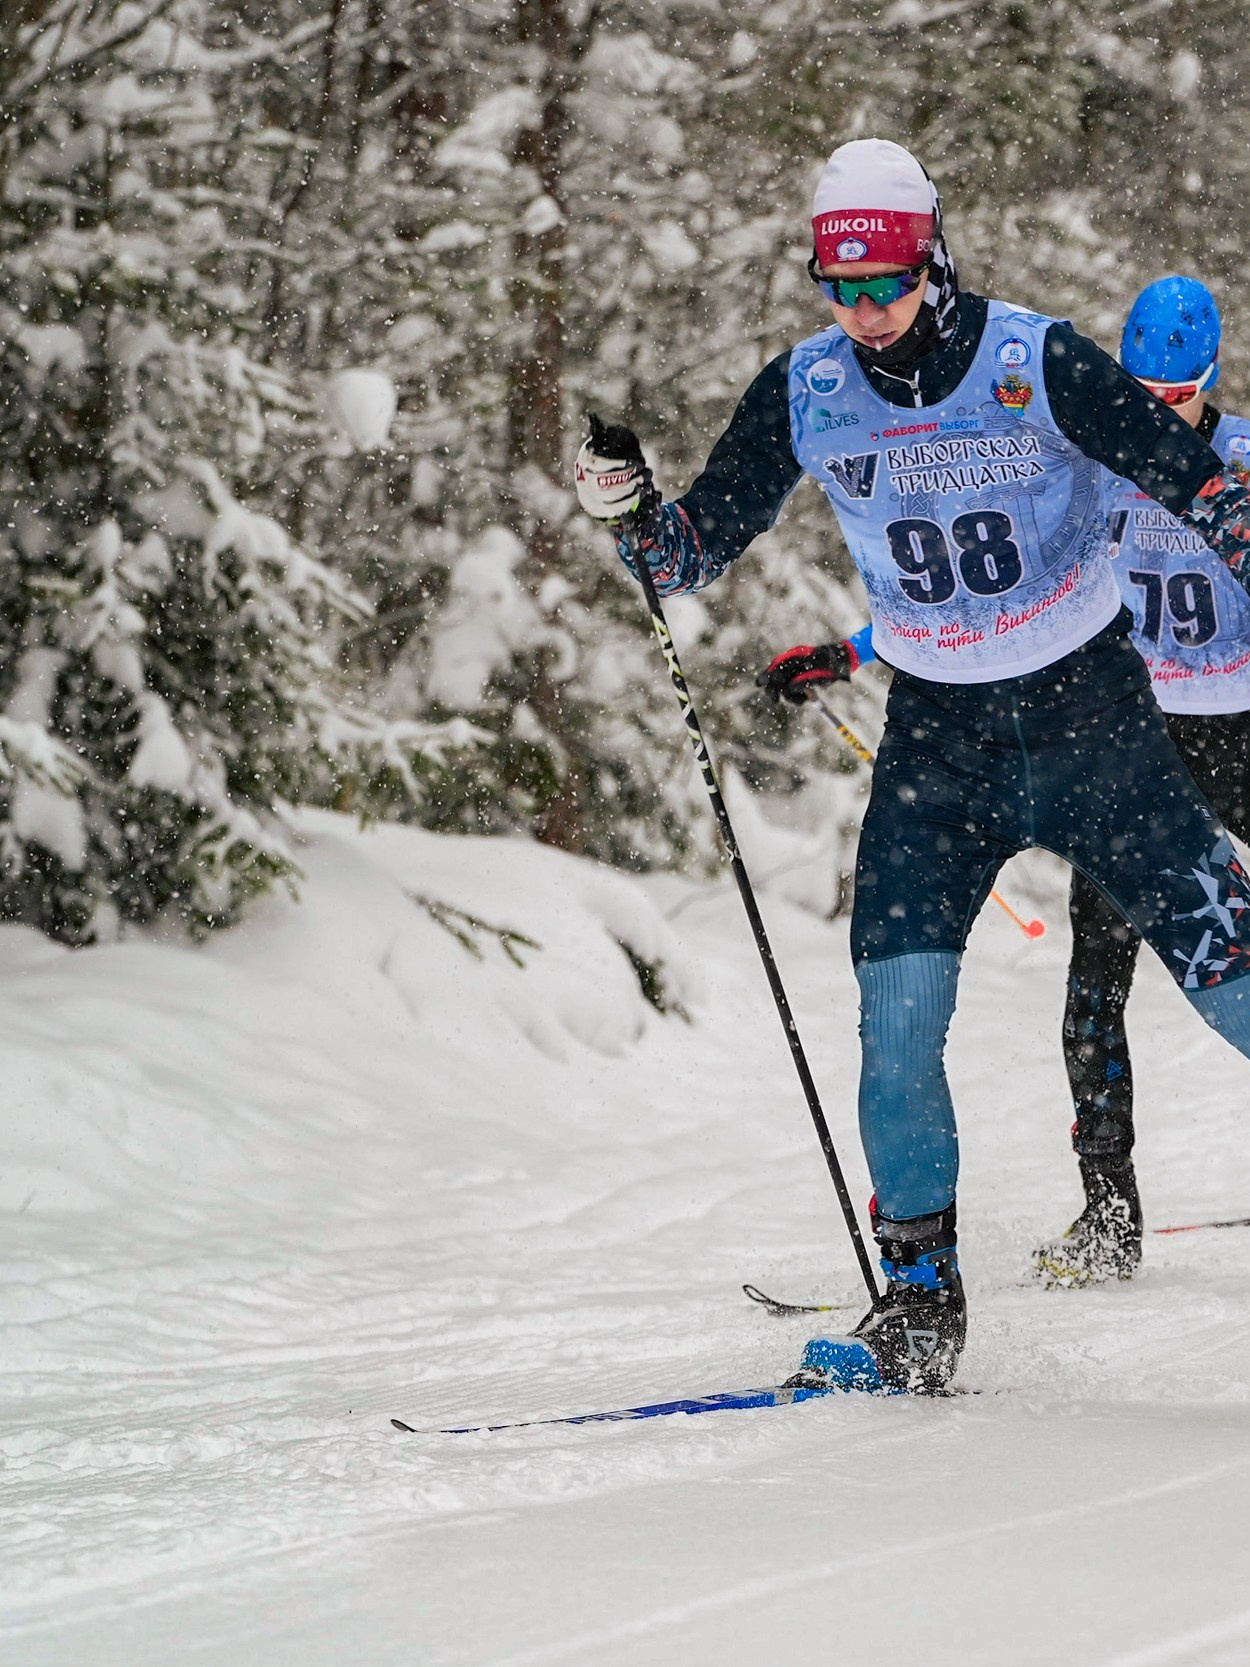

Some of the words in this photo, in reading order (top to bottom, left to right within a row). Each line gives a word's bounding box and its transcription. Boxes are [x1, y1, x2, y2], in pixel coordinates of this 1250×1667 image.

[821, 218, 887, 235] LUKOIL
[824, 413, 860, 431] ILVES
[887, 437, 1041, 471] ВЫБОРГСКАЯ
[891, 461, 1046, 496] ТРИДЦАТКА
[885, 509, 1024, 605] 98
[1129, 569, 1219, 648] 79
[937, 629, 985, 652] пути
[939, 622, 960, 635] по
